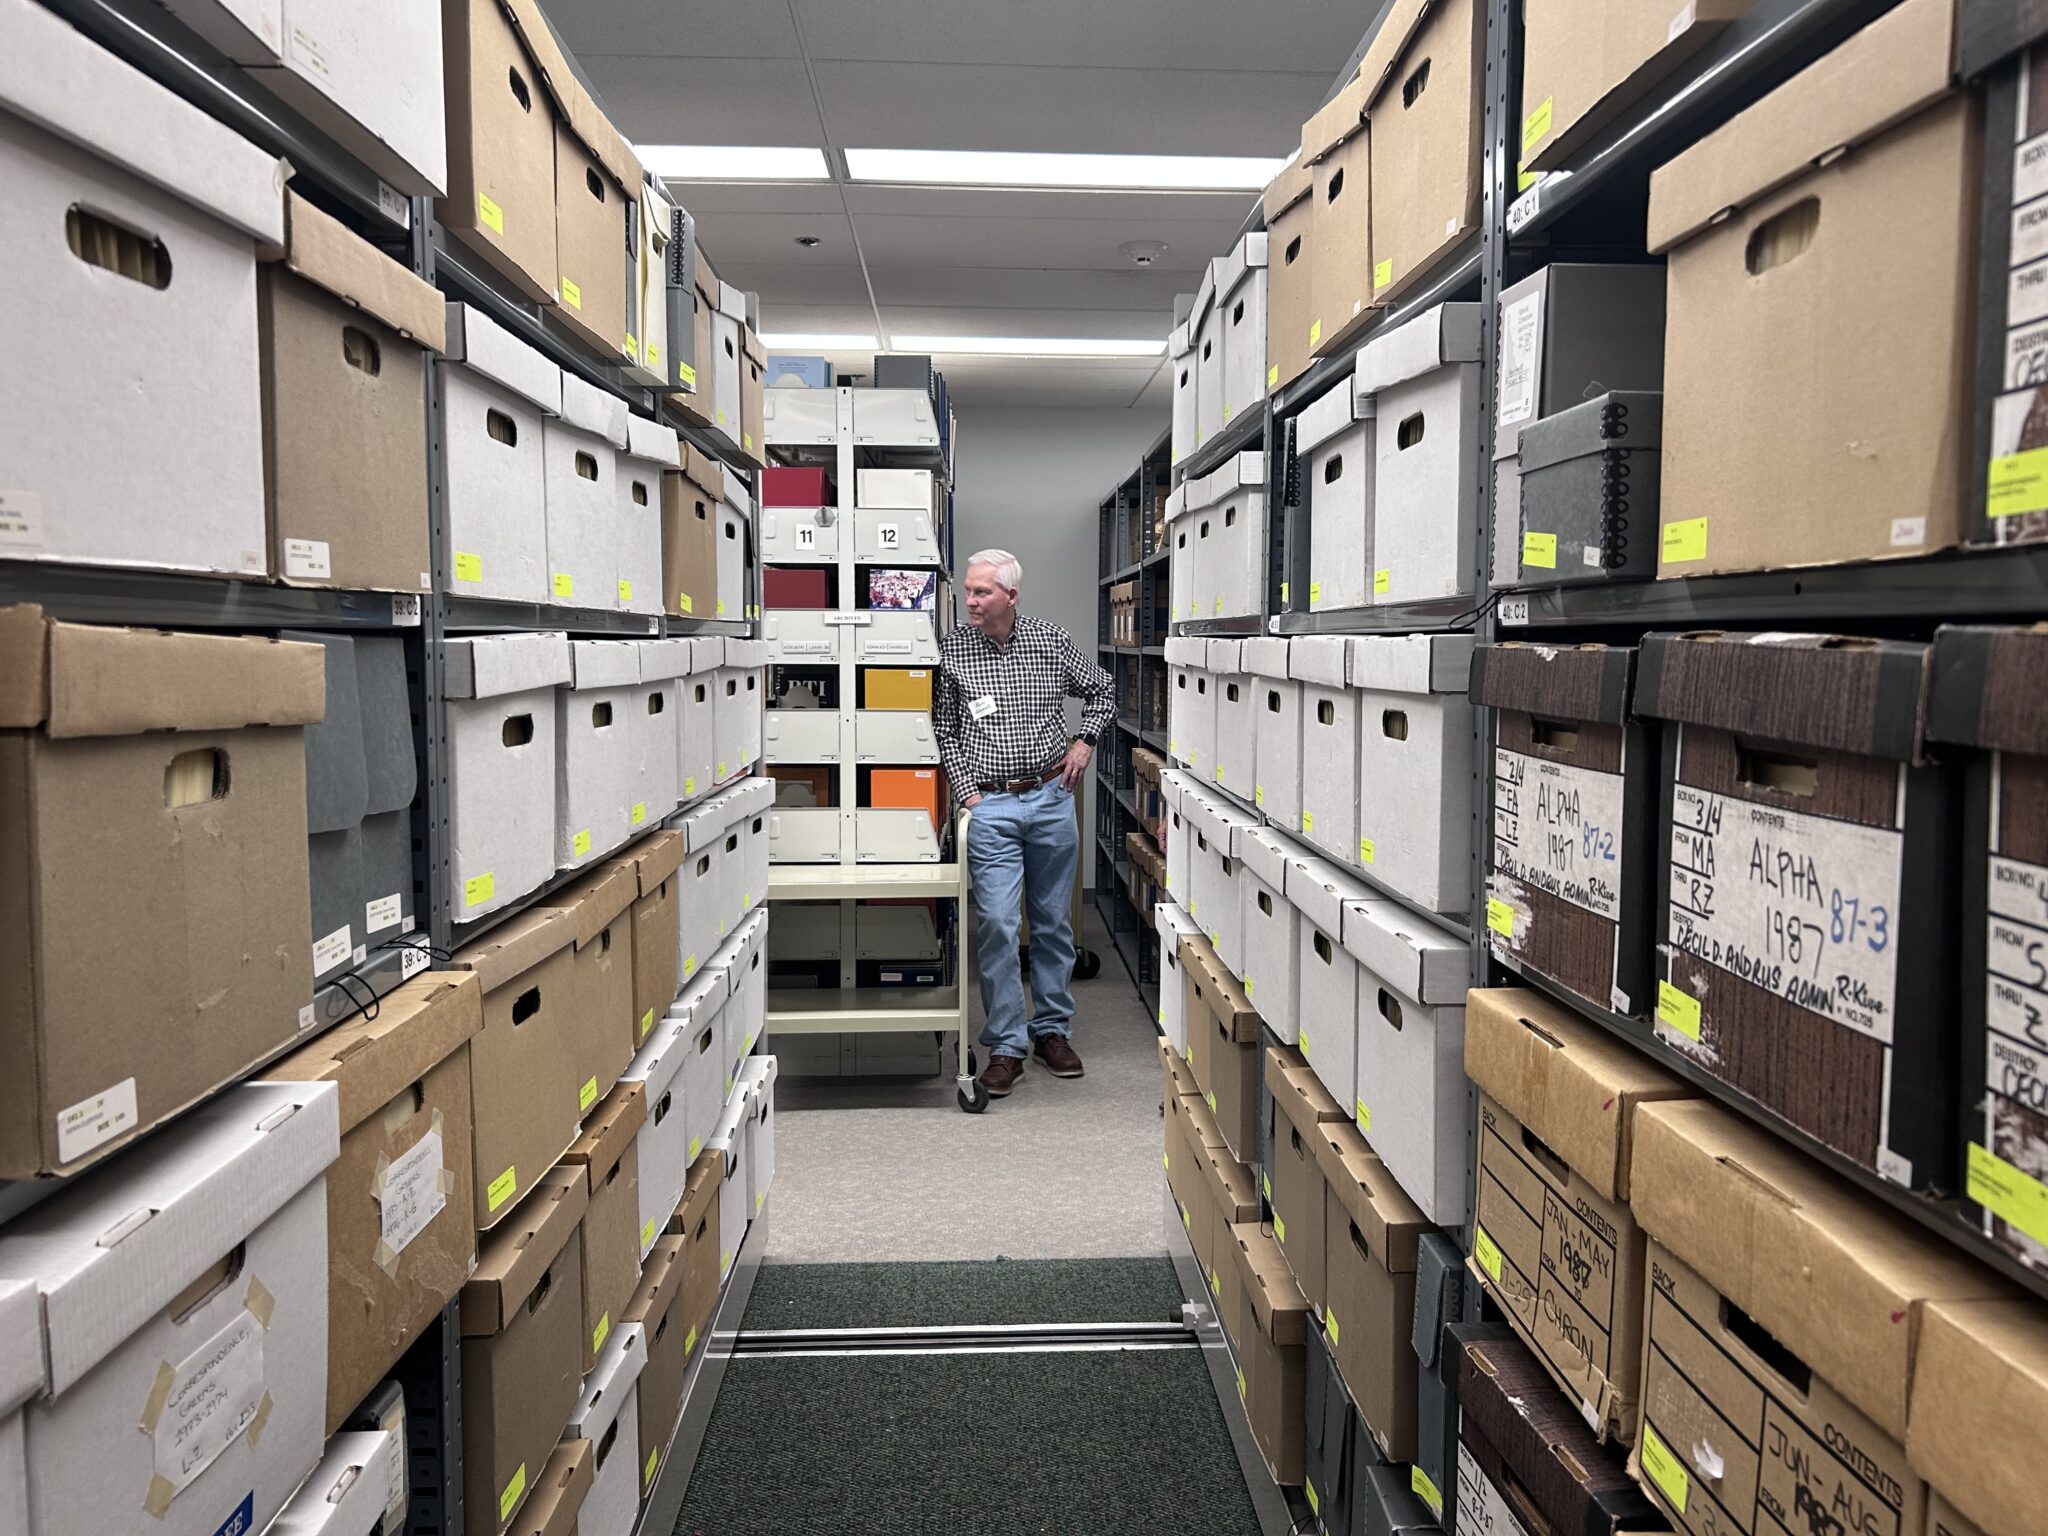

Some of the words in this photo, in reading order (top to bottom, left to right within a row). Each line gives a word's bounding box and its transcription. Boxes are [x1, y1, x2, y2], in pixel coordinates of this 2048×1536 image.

[1513, 208, 1522, 224] 40:
[800, 530, 812, 543] 11
[881, 530, 896, 542] 12
[1503, 604, 1512, 620] 40:
[1514, 604, 1520, 620] C
[1521, 604, 1526, 618] 2
[1510, 758, 1525, 787] 2/4
[1540, 764, 1560, 776] CONTENTS
[1507, 788, 1518, 815] FA
[1537, 782, 1580, 828] ALPHA
[1696, 793, 1722, 836] 3/4
[1752, 809, 1784, 828] CONTENTS
[1548, 832, 1574, 873] 1987
[1583, 820, 1616, 860] 87-2
[1675, 832, 1690, 844] FROM
[1692, 837, 1714, 877] MA
[1750, 838, 1823, 908] ALPHA
[1500, 851, 1518, 876] CECIL
[1529, 867, 1560, 896] ANDRUS
[1674, 870, 1688, 884] THRU
[1691, 878, 1714, 914] RZ
[1830, 888, 1888, 952] 87-3
[1766, 906, 1824, 979] 1987
[1994, 926, 2024, 948] FROM
[404, 952, 414, 970] 39:
[1677, 925, 1710, 958] CECIL
[1712, 940, 1722, 962] D.
[1725, 945, 1782, 990] ANDRUS
[1994, 983, 2022, 1006] THRU
[1994, 1042, 2039, 1073] DESTROY
[1482, 1106, 1496, 1130] BACK
[1576, 1196, 1618, 1246] CONTENTS
[1546, 1196, 1568, 1240] JAN
[1580, 1228, 1610, 1280] MAY
[1543, 1252, 1556, 1273] FROM
[1574, 1285, 1582, 1300] TO
[1652, 1262, 1676, 1298] BACK
[1768, 1421, 1810, 1485] JUN
[1824, 1424, 1903, 1507] CONTENTS
[1762, 1487, 1786, 1520] FROM
